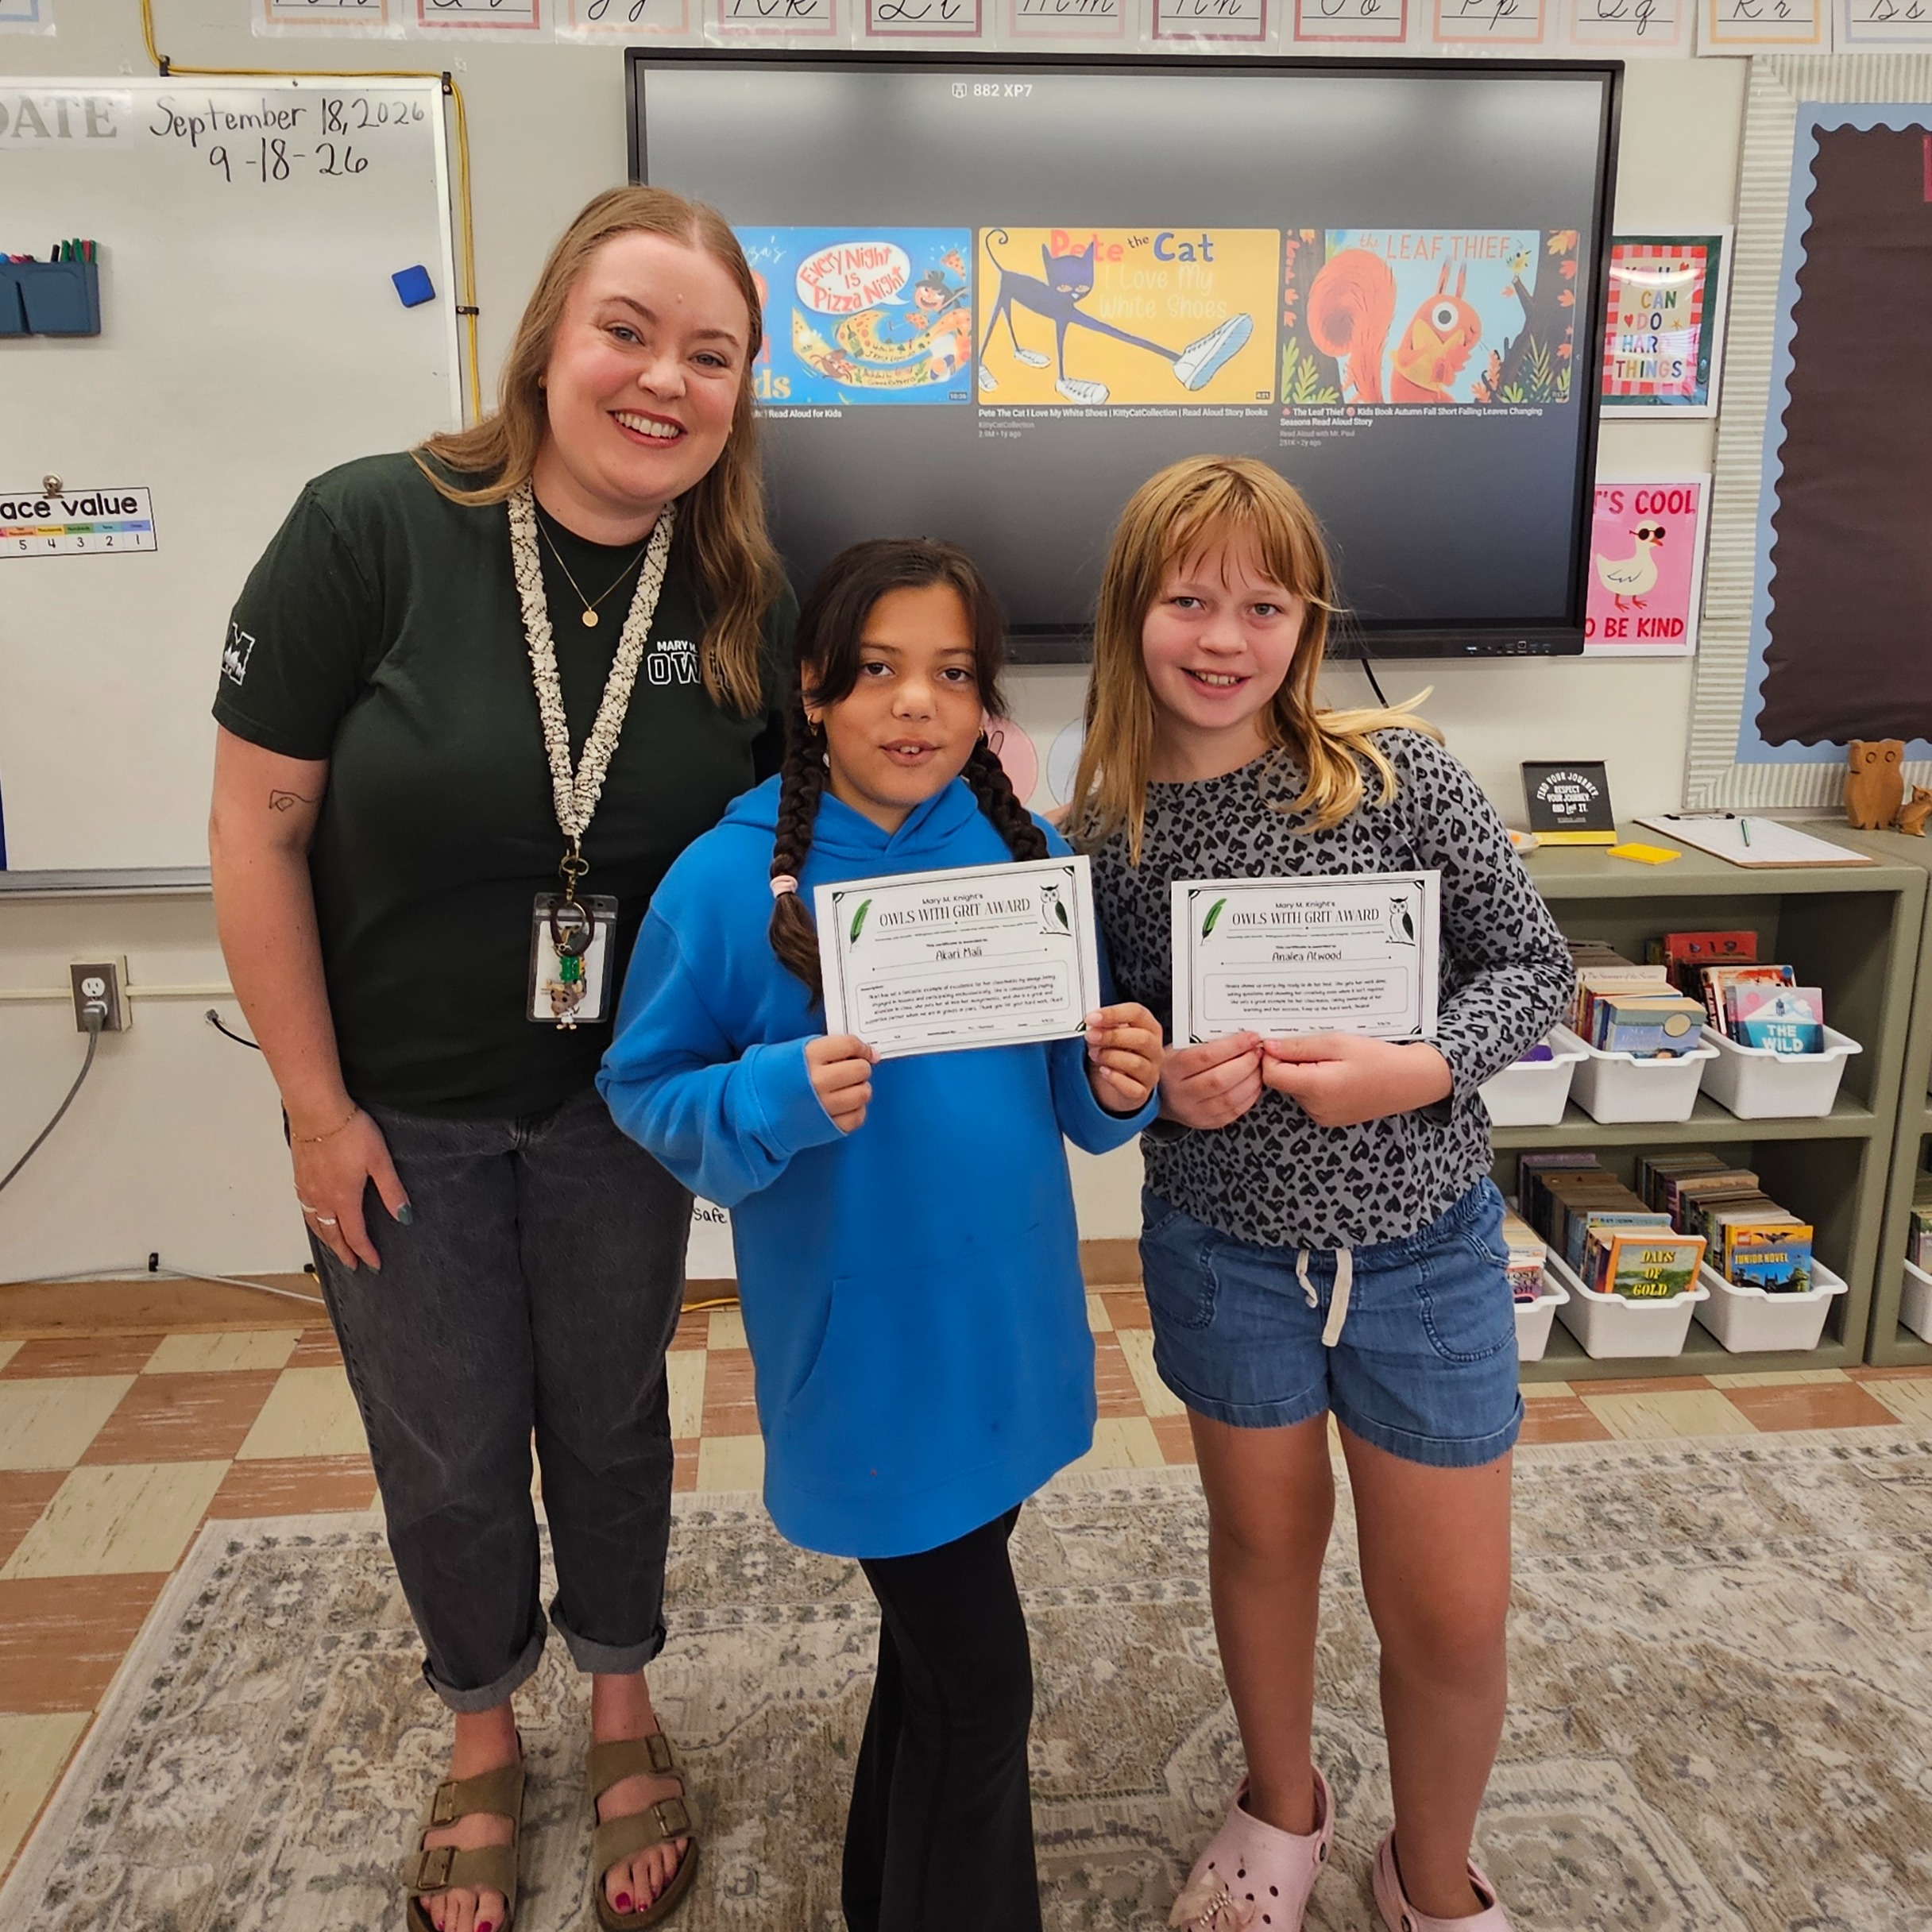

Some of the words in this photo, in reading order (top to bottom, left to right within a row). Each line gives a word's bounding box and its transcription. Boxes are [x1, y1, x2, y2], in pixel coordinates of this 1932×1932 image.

[973, 83, 1000, 97] 882
[1003, 83, 1033, 97] XP7
[149, 95, 307, 149] September
[1126, 235, 1150, 249] the
[1153, 232, 1214, 262] Cat
[1386, 234, 1444, 261] LEAF
[1450, 235, 1511, 261] THIEF
[1119, 265, 1169, 290] Love
[1178, 264, 1214, 296] My
[813, 284, 863, 312] Pizza
[1099, 294, 1157, 319] White
[1166, 293, 1227, 319] Shoes
[1640, 290, 1677, 309] CAN
[1636, 312, 1663, 330] DO
[1622, 334, 1665, 354] HAR
[1615, 360, 1683, 378] THINGS
[768, 409, 788, 419] Read
[789, 409, 812, 419] Aloud
[812, 409, 823, 419] for
[824, 409, 843, 419] Kids
[978, 408, 995, 418] Pete
[997, 408, 1011, 418] The
[1012, 408, 1026, 418] Cat
[1030, 408, 1049, 418] Love
[1049, 409, 1061, 419] My
[1062, 408, 1084, 418] White
[1085, 408, 1107, 418] Shoes
[1182, 408, 1201, 417] Read
[1202, 408, 1224, 417] Aloud
[1225, 408, 1244, 418] Story
[1245, 408, 1268, 417] Books
[1293, 408, 1308, 416] The
[1308, 408, 1324, 416] Leaf
[1326, 408, 1344, 416] Thief
[1357, 408, 1374, 416] Kids
[1374, 408, 1393, 416] Book
[1394, 408, 1423, 416] Autumn
[1438, 407, 1457, 415] Short
[1483, 407, 1508, 415] Leaves
[1509, 407, 1543, 416] Changing
[1312, 418, 1331, 427] Read
[1331, 418, 1353, 427] Aloud
[1354, 418, 1374, 427] Story
[61, 493, 138, 516] value
[1635, 489, 1695, 514] COOL
[18, 539, 27, 551] 5
[47, 539, 56, 549] 4
[77, 537, 84, 547] 3
[105, 535, 114, 547] 2
[135, 534, 141, 545] 1
[1604, 617, 1629, 638] BE
[1636, 617, 1684, 638] KIND
[657, 640, 688, 651] MARY
[1546, 771, 1567, 789] YOUR
[953, 893, 983, 902] Knight's
[879, 910, 915, 927] OWLS
[918, 906, 950, 922] WITH
[952, 902, 981, 918] GRIT
[985, 898, 1030, 915] AWARD
[1232, 912, 1268, 925] OWLS
[1270, 911, 1301, 924] WITH
[1304, 910, 1332, 923] GRIT
[1335, 908, 1380, 922] AWARD
[1306, 949, 1343, 961] Atwood
[1766, 1024, 1797, 1037] THE
[1760, 1037, 1805, 1053] WILD
[692, 1207, 728, 1224] Safe
[1640, 1249, 1676, 1265] DAYS
[1734, 1254, 1763, 1265] JUNIOR
[1764, 1252, 1788, 1264] NOVEL
[1644, 1268, 1663, 1280] OF
[1632, 1283, 1668, 1296] GOLD
